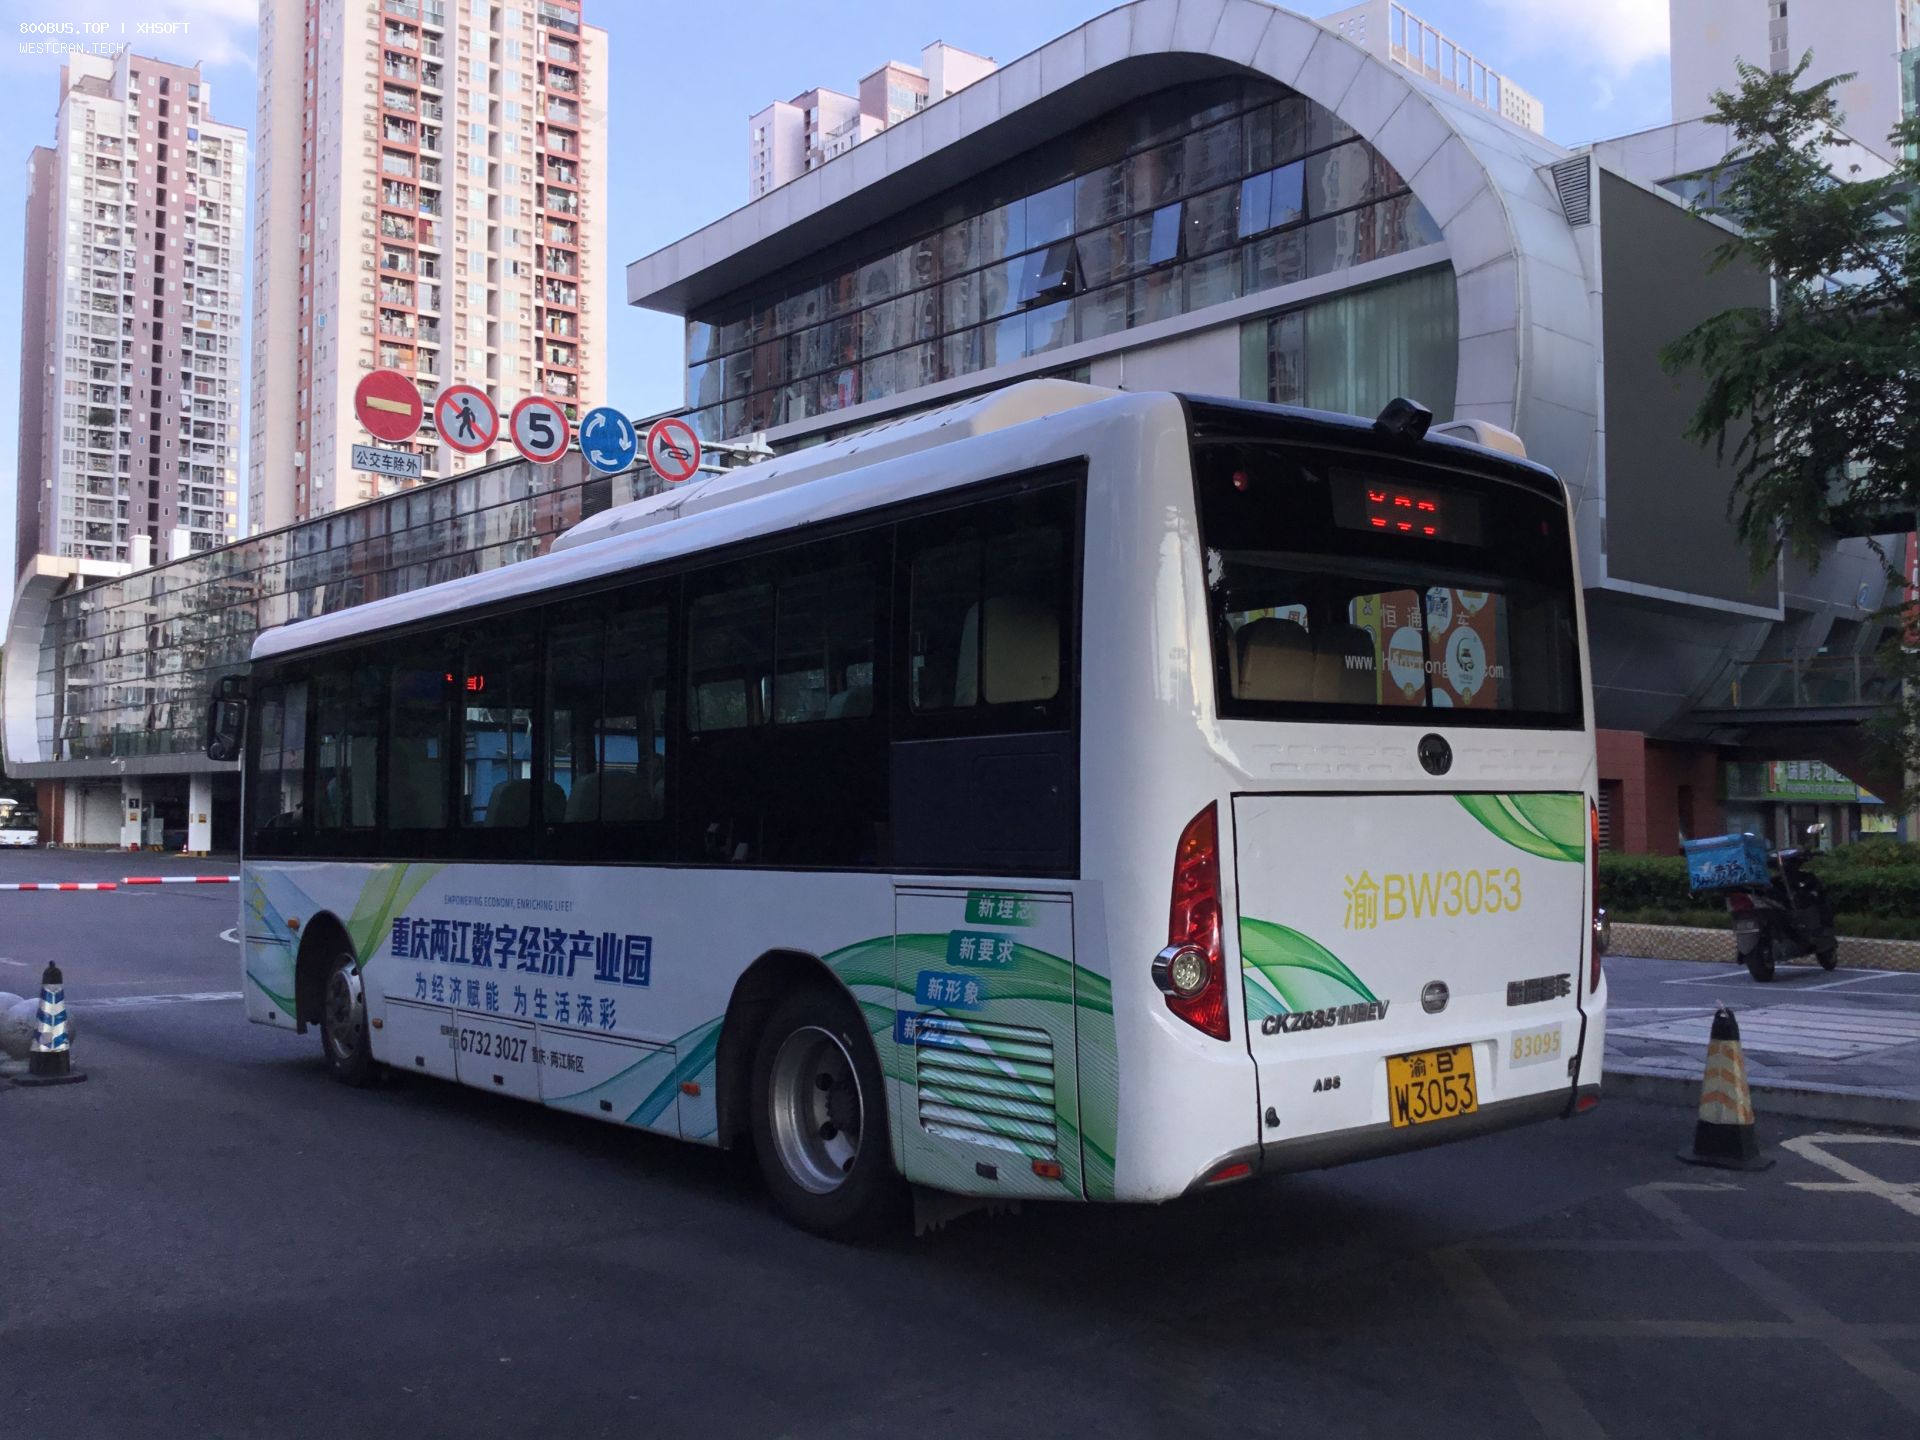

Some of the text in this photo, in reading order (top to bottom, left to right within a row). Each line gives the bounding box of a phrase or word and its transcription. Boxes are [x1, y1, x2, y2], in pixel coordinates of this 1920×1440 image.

[528, 412, 555, 450] 5
[356, 448, 419, 474] 公交车除外
[444, 894, 483, 907] EMPOWERING
[516, 898, 553, 912] ENRICHING
[978, 894, 1032, 920] 新理念
[1343, 867, 1522, 930] 渝BW3053
[391, 916, 653, 987] 重庆两江数字经济产业园
[959, 936, 1015, 963] 新要求
[414, 971, 617, 1031] 为经济赋能 为生活添彩
[927, 976, 979, 1004] 新形象
[460, 1028, 491, 1057] 6732
[494, 1034, 528, 1063] 3027
[1513, 1030, 1561, 1060] 83095
[1312, 1075, 1341, 1093] ABS
[1395, 1073, 1473, 1122] W3053
